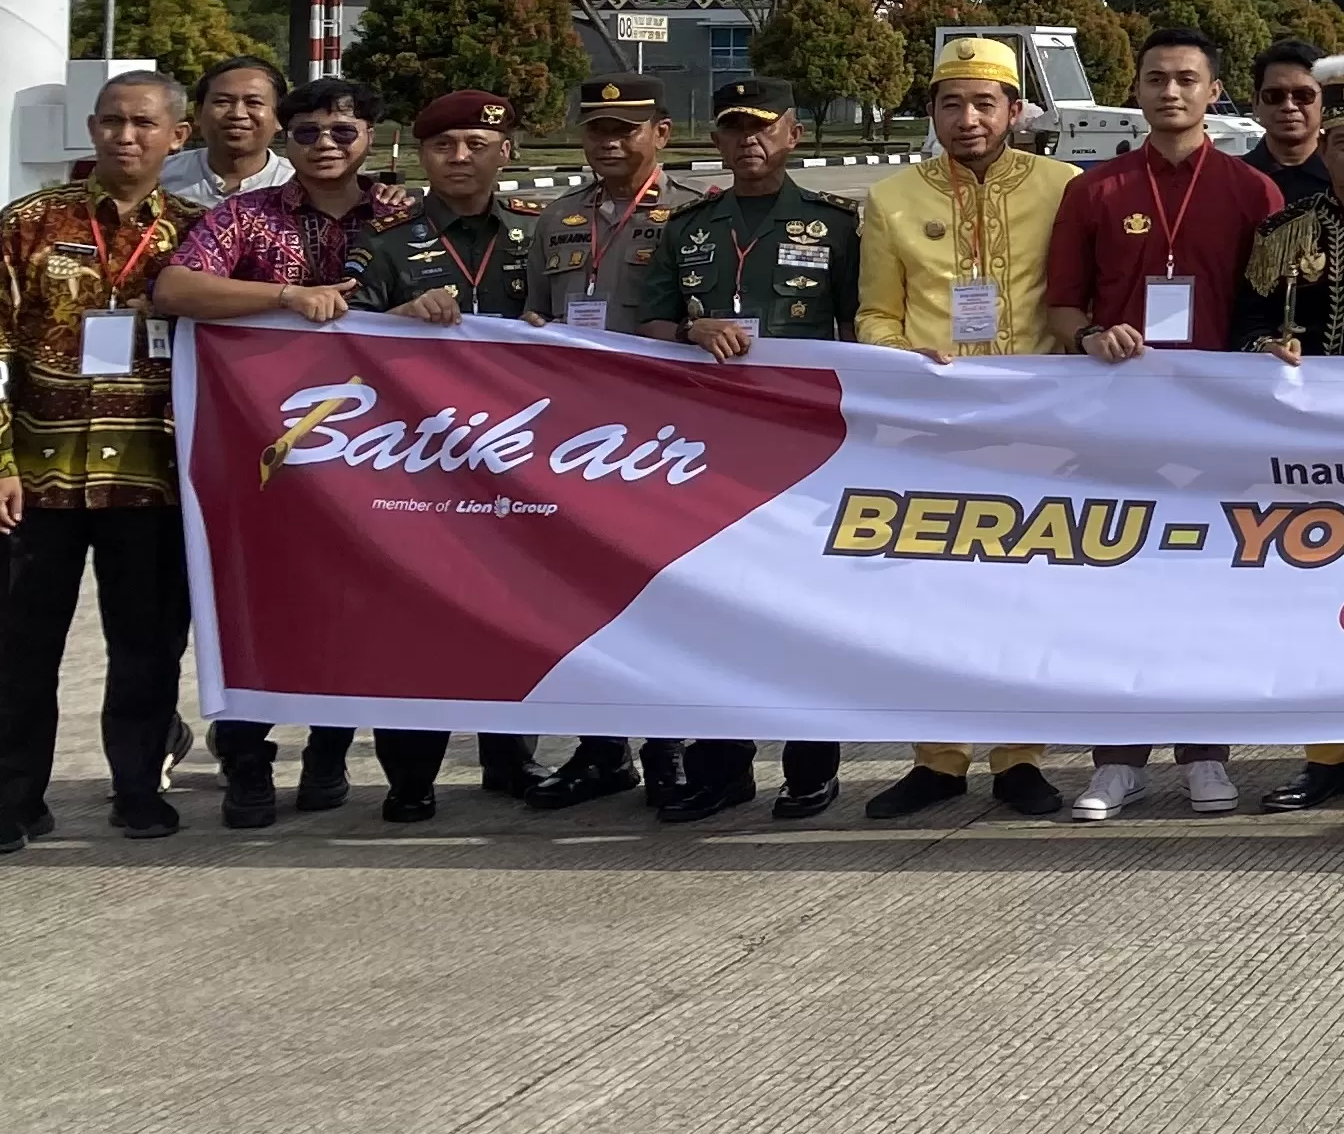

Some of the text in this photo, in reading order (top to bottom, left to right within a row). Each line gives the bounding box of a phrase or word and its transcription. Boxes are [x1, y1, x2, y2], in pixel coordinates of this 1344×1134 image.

[619, 17, 632, 38] 08
[262, 375, 708, 485] Batik air
[371, 498, 558, 517] member of Lion Group
[824, 487, 1156, 567] BERAU
